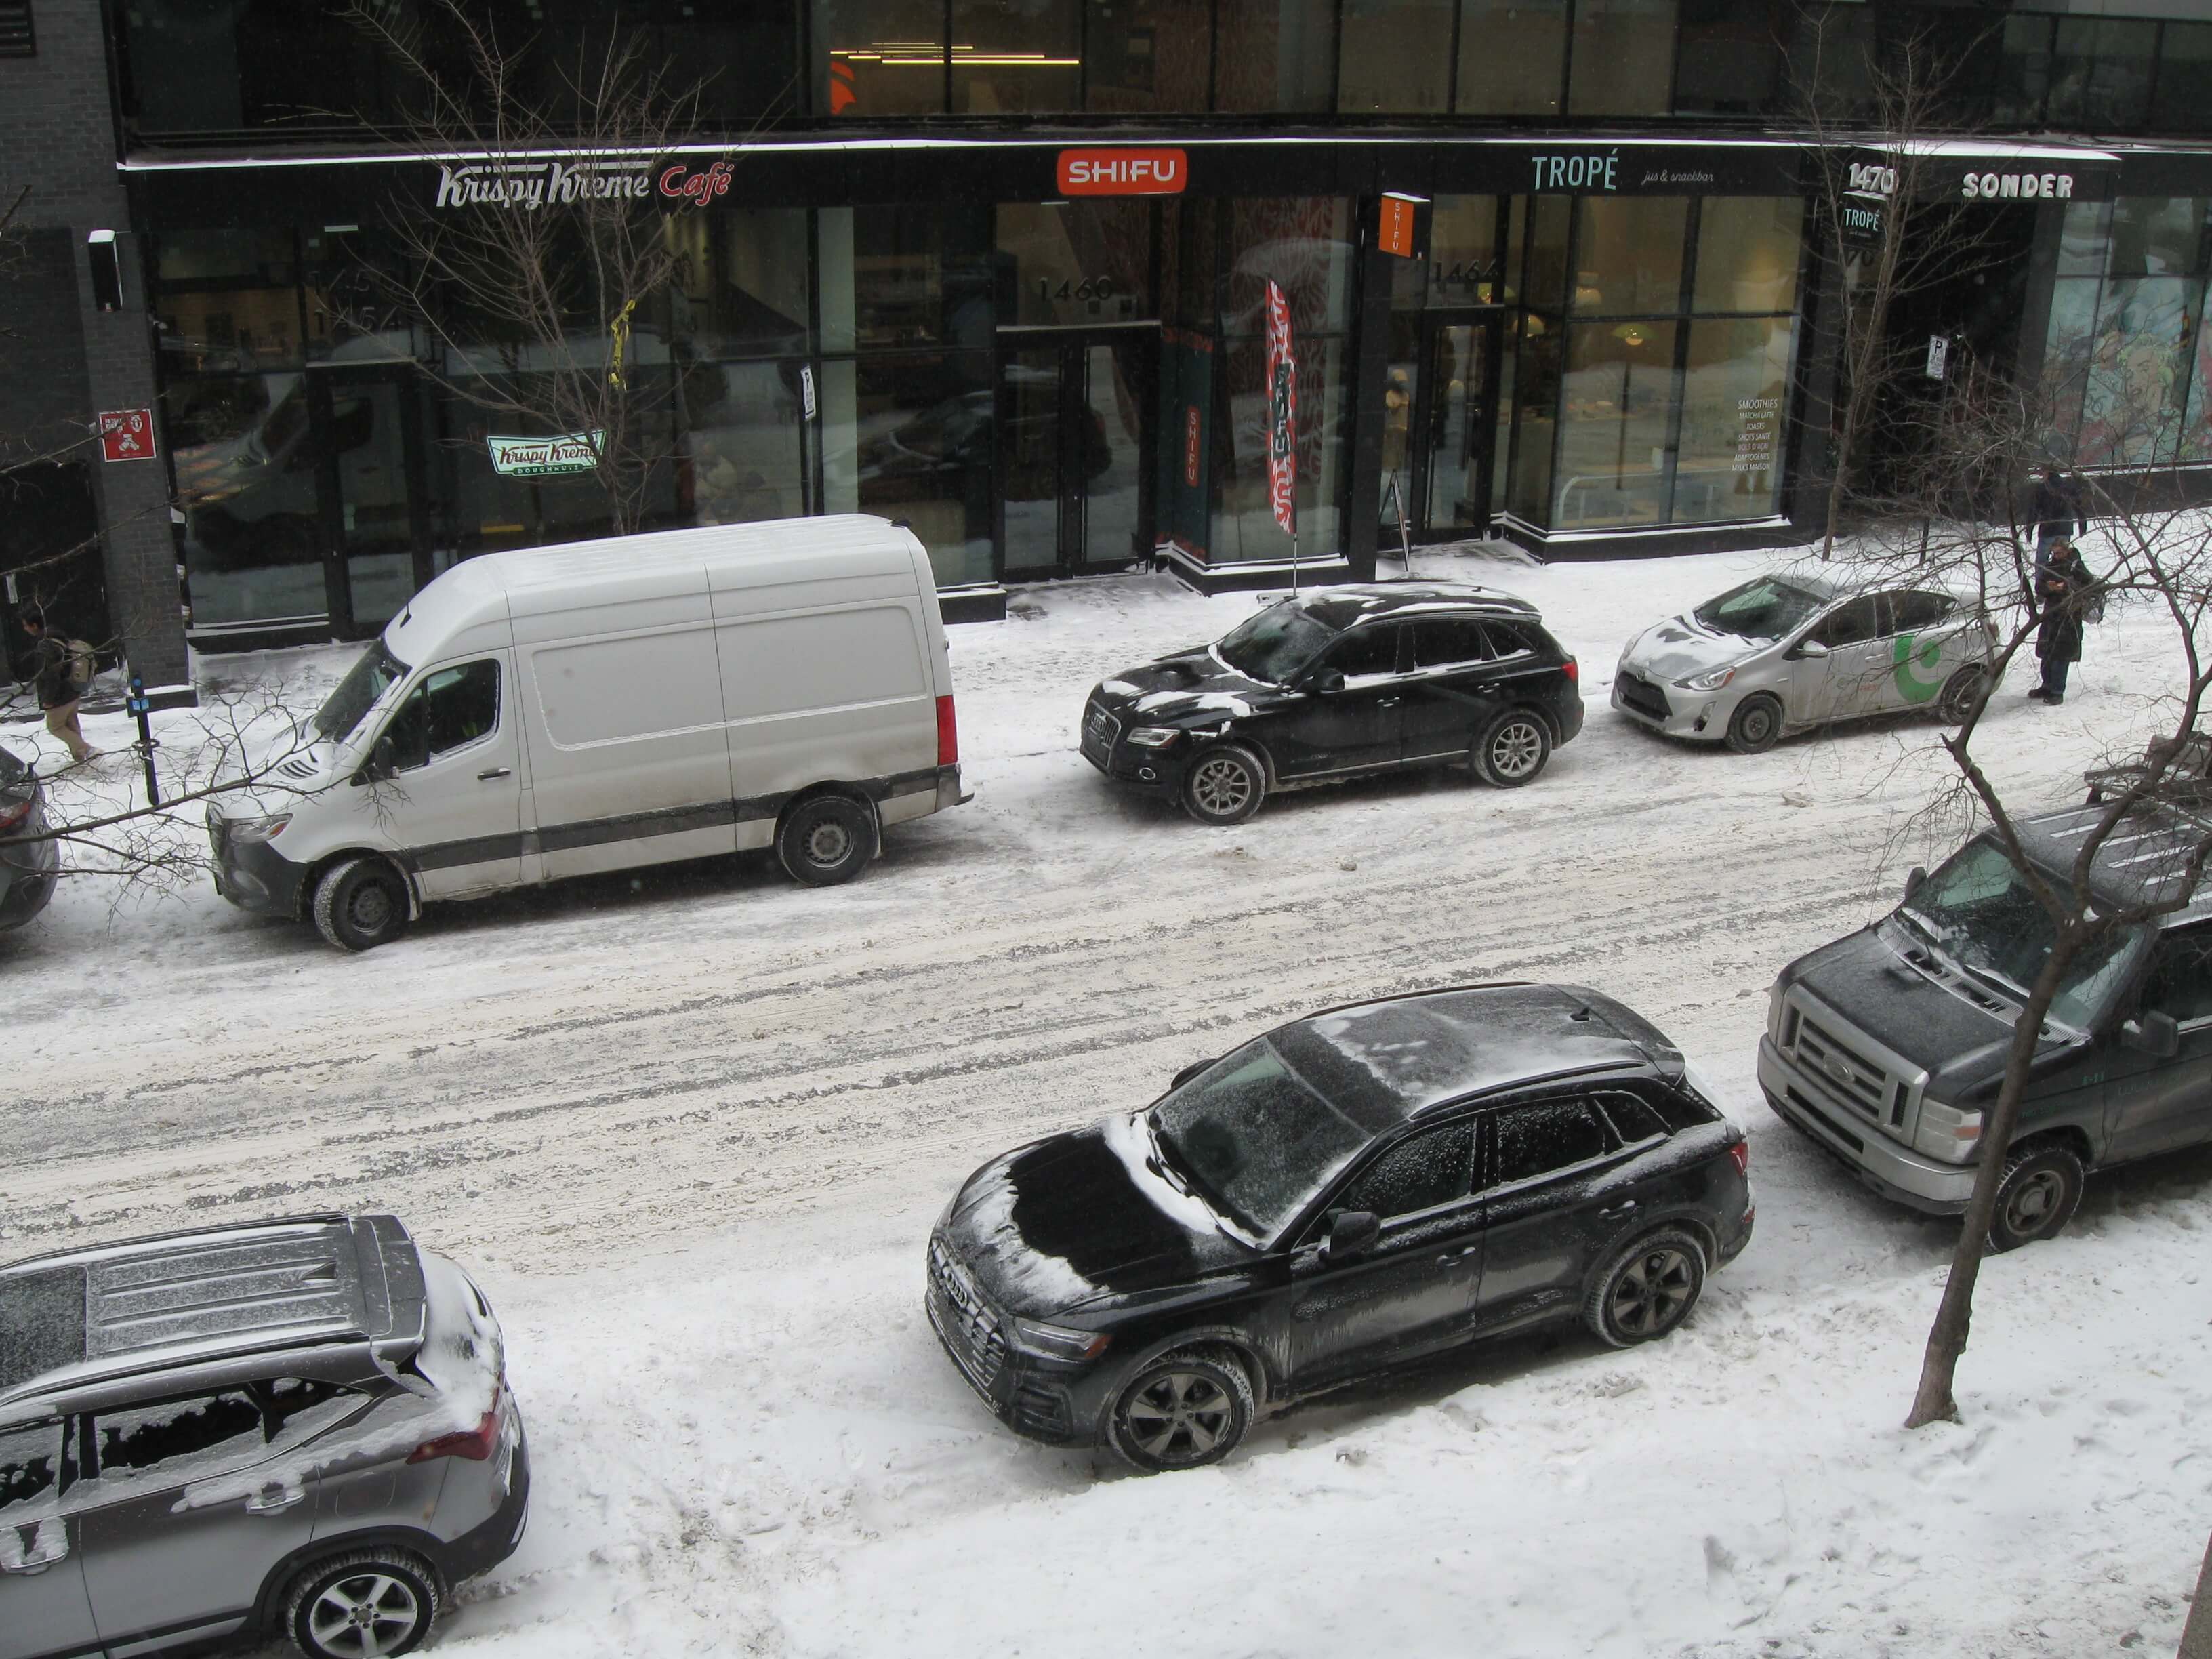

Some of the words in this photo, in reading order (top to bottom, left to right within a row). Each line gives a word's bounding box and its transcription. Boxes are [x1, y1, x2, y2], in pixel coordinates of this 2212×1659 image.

[1069, 160, 1175, 182] SHIFU
[1532, 148, 1618, 190] TROPÉ
[1641, 171, 1658, 184] jus
[1849, 163, 1899, 194] 1470
[436, 163, 548, 209] Krispy
[547, 161, 655, 203] Kreme
[659, 162, 735, 206] Café
[1961, 173, 2074, 199] SONDER
[1393, 203, 1401, 250] SHIFU
[1845, 209, 1880, 232] TROPÉ
[1040, 276, 1113, 301] 1460
[1738, 398, 1778, 409] SMOOTHIES
[499, 445, 548, 464] Krispy
[1188, 411, 1197, 480] SHIFU
